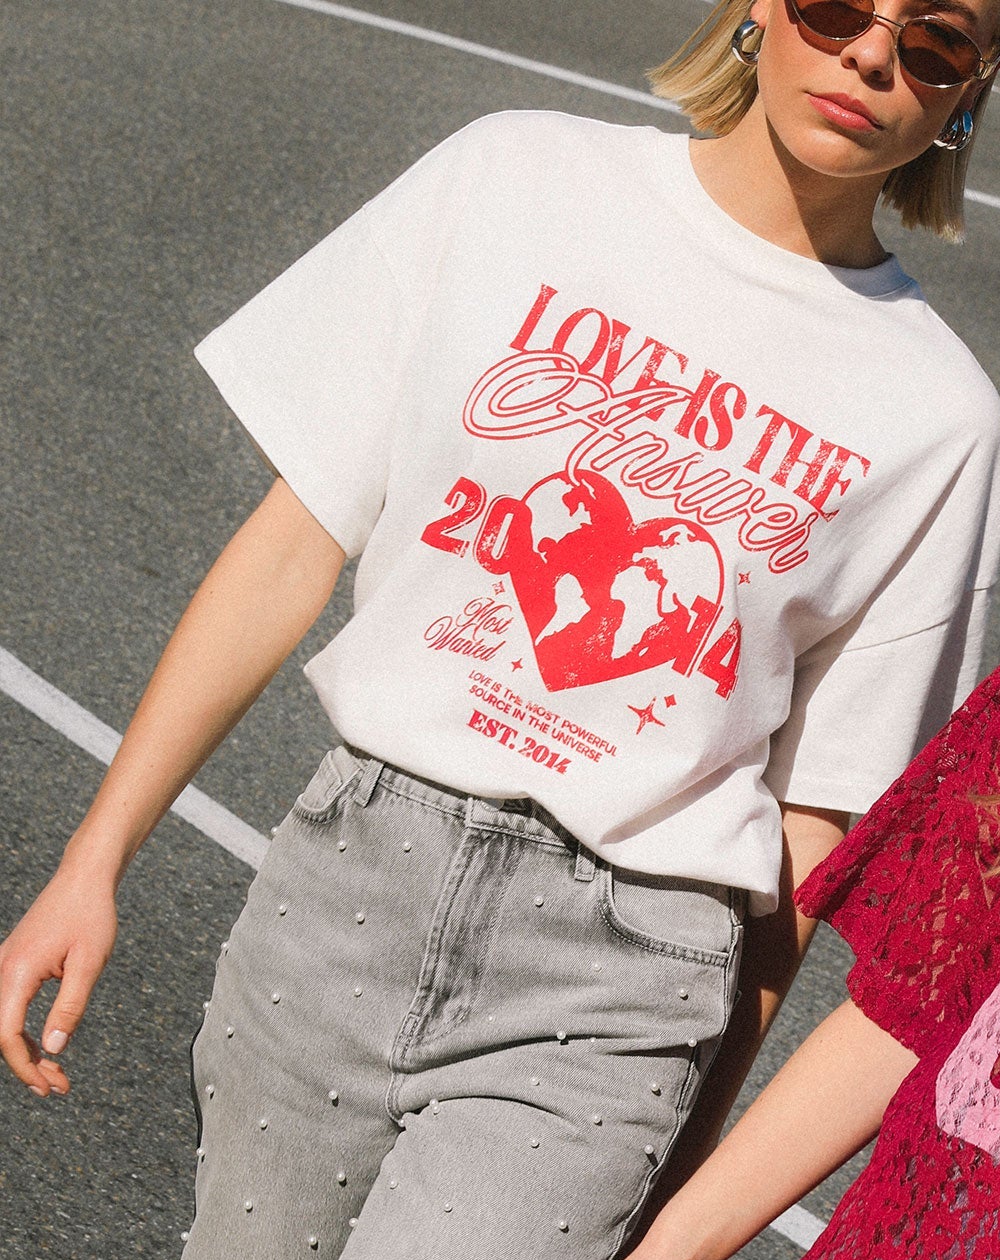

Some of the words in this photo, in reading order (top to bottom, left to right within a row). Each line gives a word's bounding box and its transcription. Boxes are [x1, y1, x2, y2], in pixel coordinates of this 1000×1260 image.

[509, 282, 689, 422] LOVE
[675, 367, 747, 453] IS
[742, 404, 871, 524] THE
[463, 350, 821, 575] Answer
[424, 615, 507, 662] Wanted
[456, 597, 513, 641] Most
[466, 708, 519, 750] EST.
[518, 736, 573, 775] 2014
[468, 669, 492, 687] LOVE
[492, 681, 502, 693] IS
[504, 687, 523, 706] THE
[525, 701, 561, 725] MOST
[561, 719, 619, 757] POWERFUL
[468, 684, 513, 715] SOURCE
[512, 708, 527, 722] IN
[528, 715, 550, 734] THE
[551, 727, 603, 763] UNIVERSE
